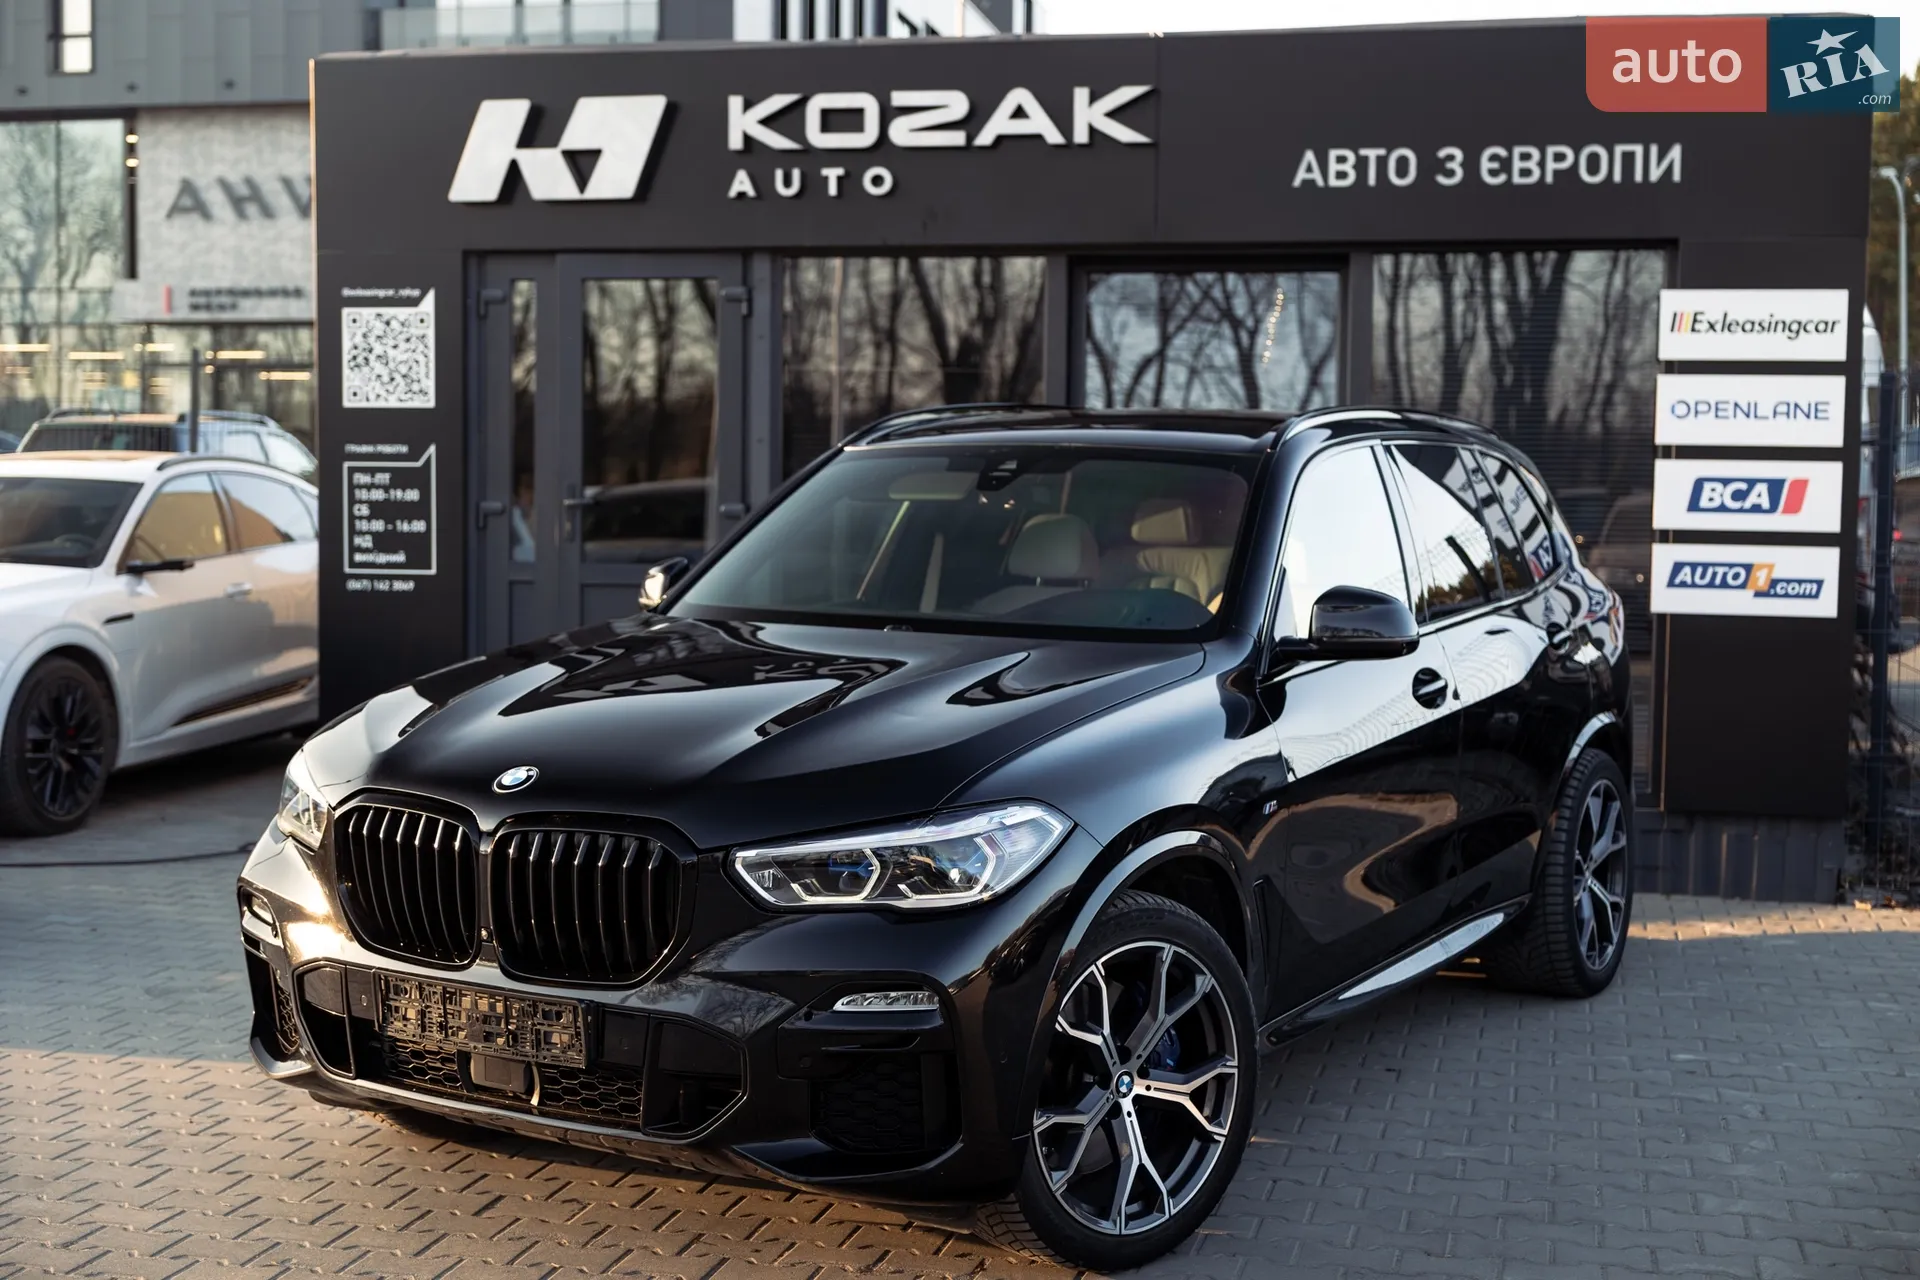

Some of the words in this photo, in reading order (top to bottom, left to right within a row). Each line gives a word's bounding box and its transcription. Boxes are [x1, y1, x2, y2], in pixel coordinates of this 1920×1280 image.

[727, 85, 1153, 151] KOZAK
[1292, 147, 1418, 188] АВТО
[1479, 143, 1683, 186] ЄВРОПИ
[727, 166, 894, 199] AUTO
[1690, 311, 1840, 341] Exleasingcar
[1670, 400, 1831, 421] OPENLANE
[1698, 481, 1771, 511] BCA
